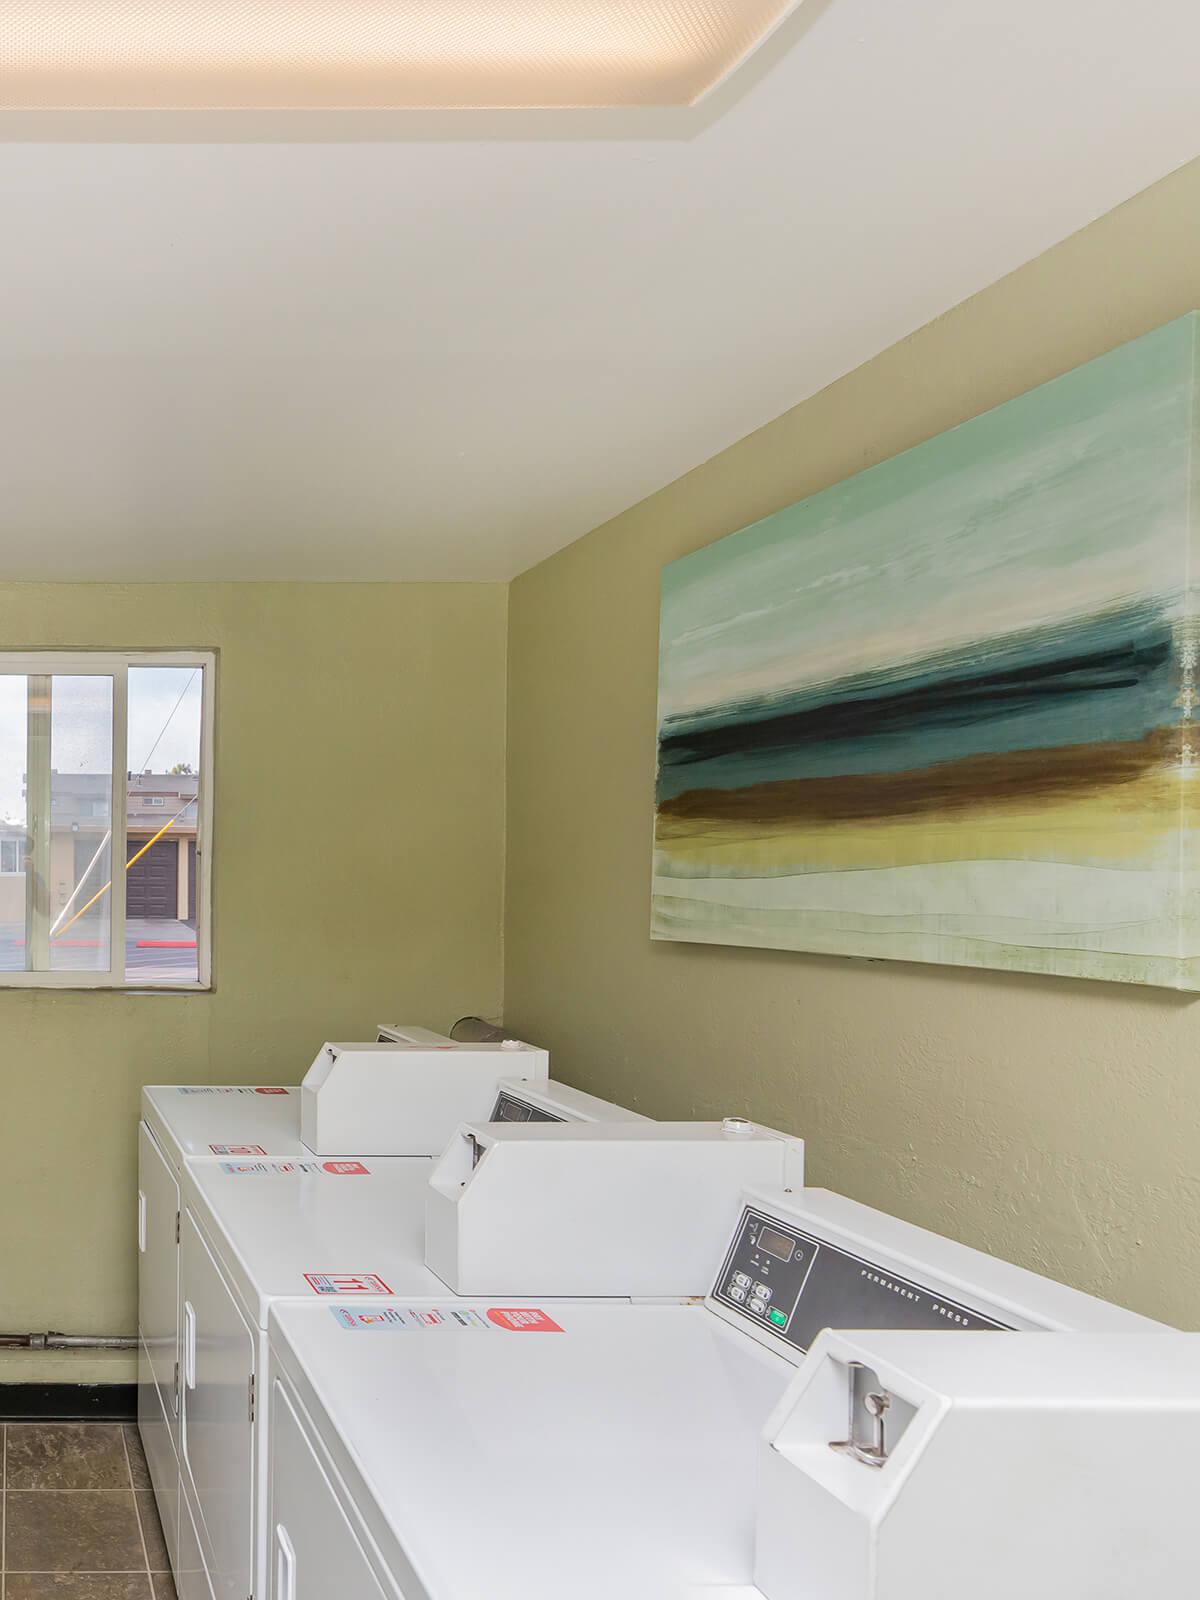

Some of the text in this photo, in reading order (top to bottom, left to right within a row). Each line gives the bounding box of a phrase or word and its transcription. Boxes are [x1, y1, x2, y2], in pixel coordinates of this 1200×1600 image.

[333, 1278, 369, 1290] 11
[861, 1269, 969, 1326] PERMANENT PRESS
